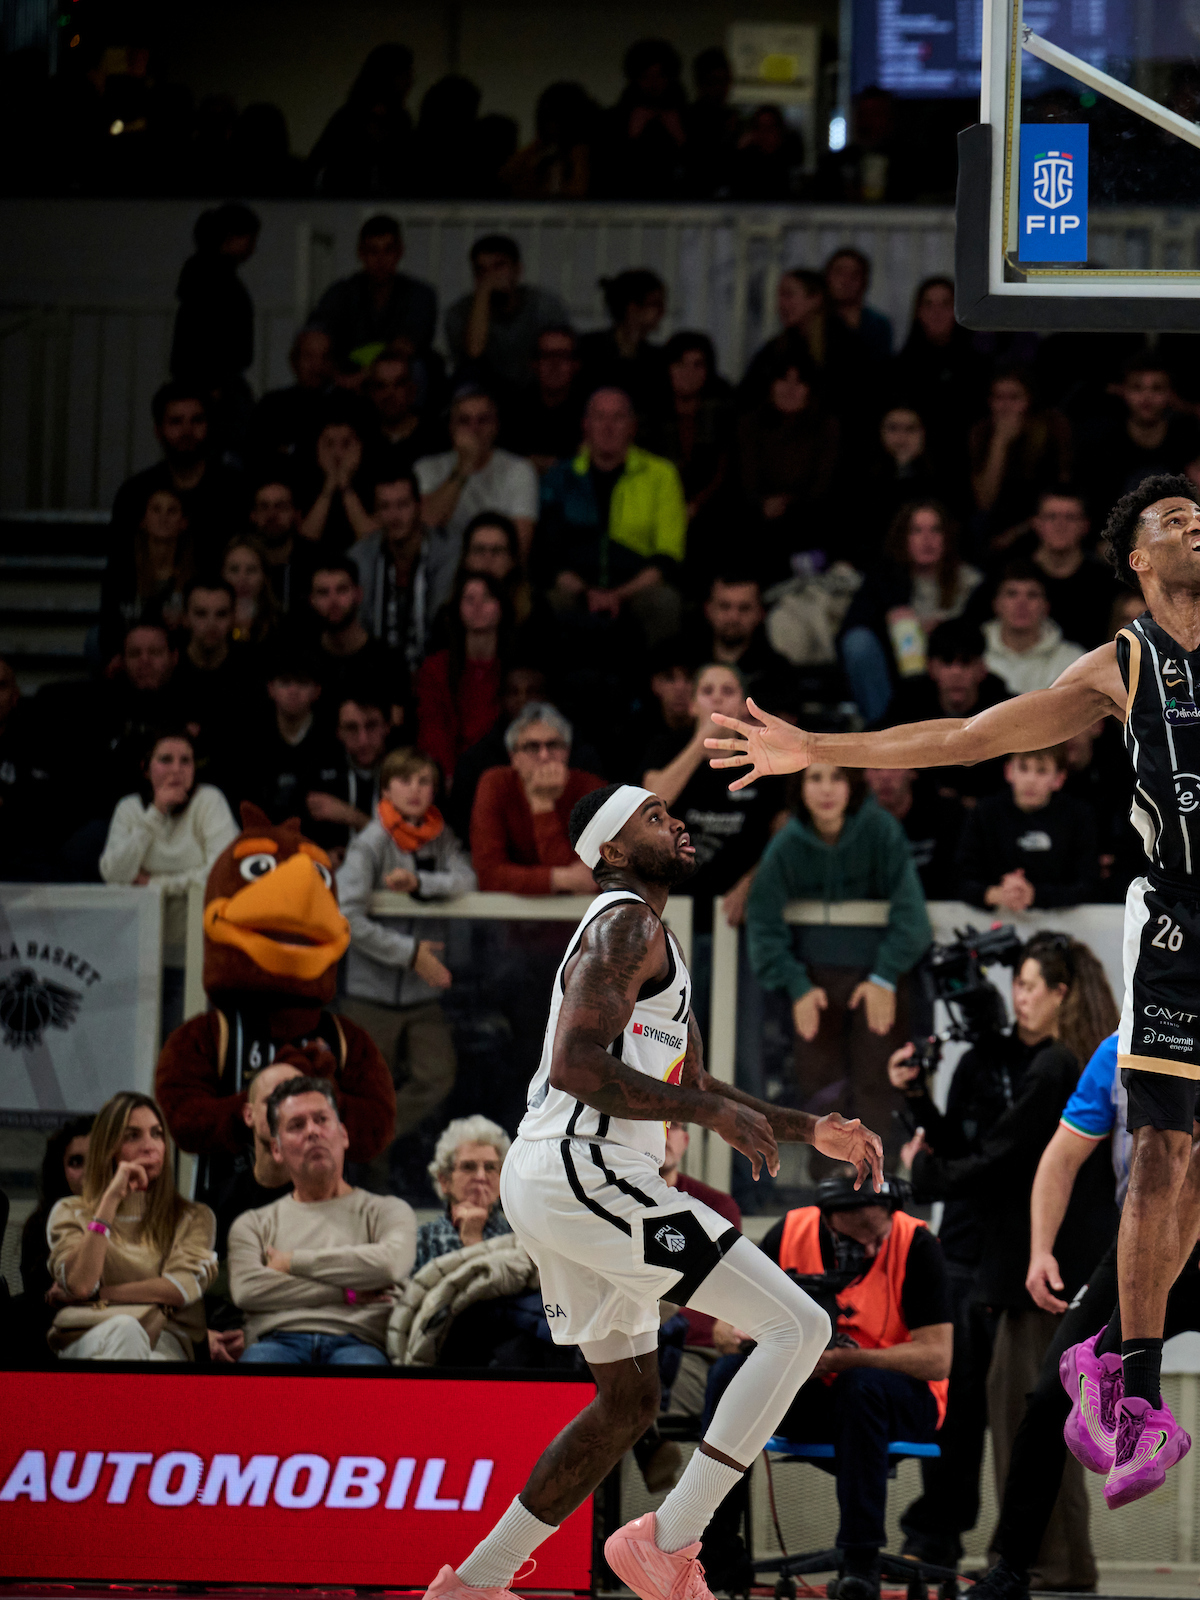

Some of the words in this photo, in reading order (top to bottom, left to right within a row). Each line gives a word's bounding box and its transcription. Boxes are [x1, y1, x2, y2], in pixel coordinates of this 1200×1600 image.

[1026, 215, 1080, 235] FIP
[1151, 914, 1184, 952] 26
[27, 940, 102, 987] BASKET
[1143, 1004, 1199, 1024] CAVIT
[643, 1025, 684, 1050] SYNERGIE
[1156, 1033, 1194, 1046] Dolomiti
[1169, 1043, 1194, 1053] energia
[654, 1224, 672, 1242] APU
[0, 1449, 495, 1512] AUTOMOBILI
